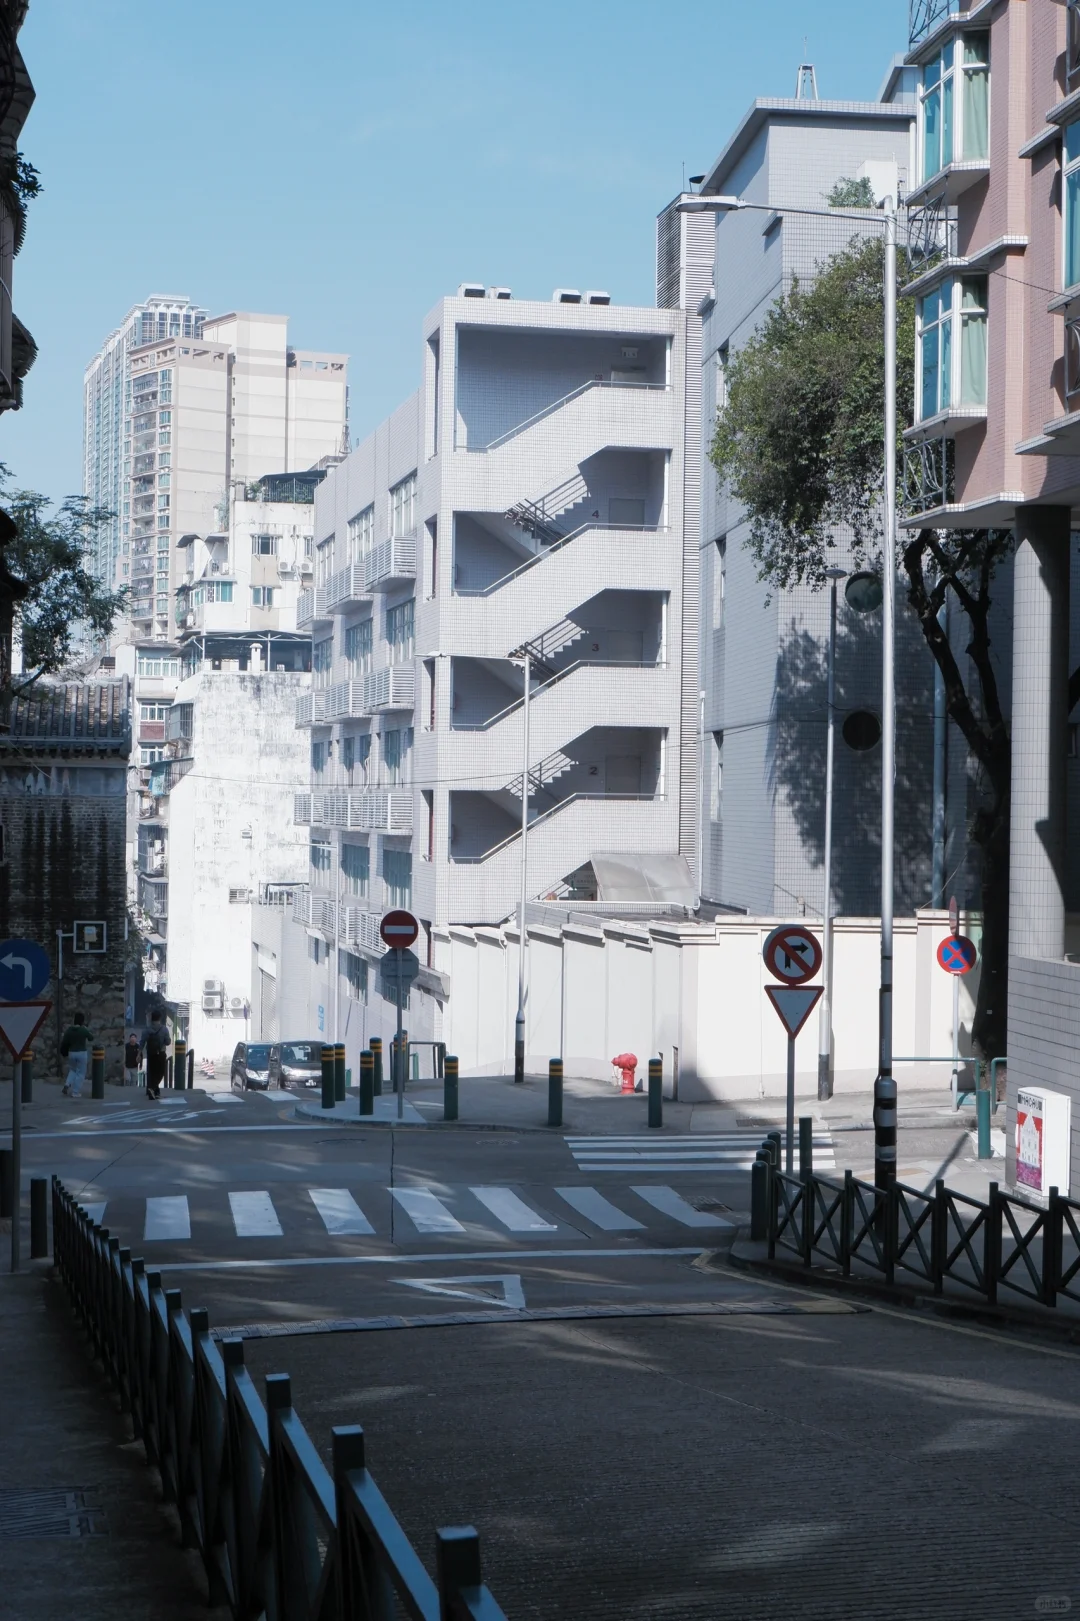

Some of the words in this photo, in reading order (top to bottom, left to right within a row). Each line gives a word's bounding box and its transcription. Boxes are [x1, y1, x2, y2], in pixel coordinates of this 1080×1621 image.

[592, 509, 599, 518] 4
[592, 643, 599, 652] 3
[589, 766, 598, 775] 2
